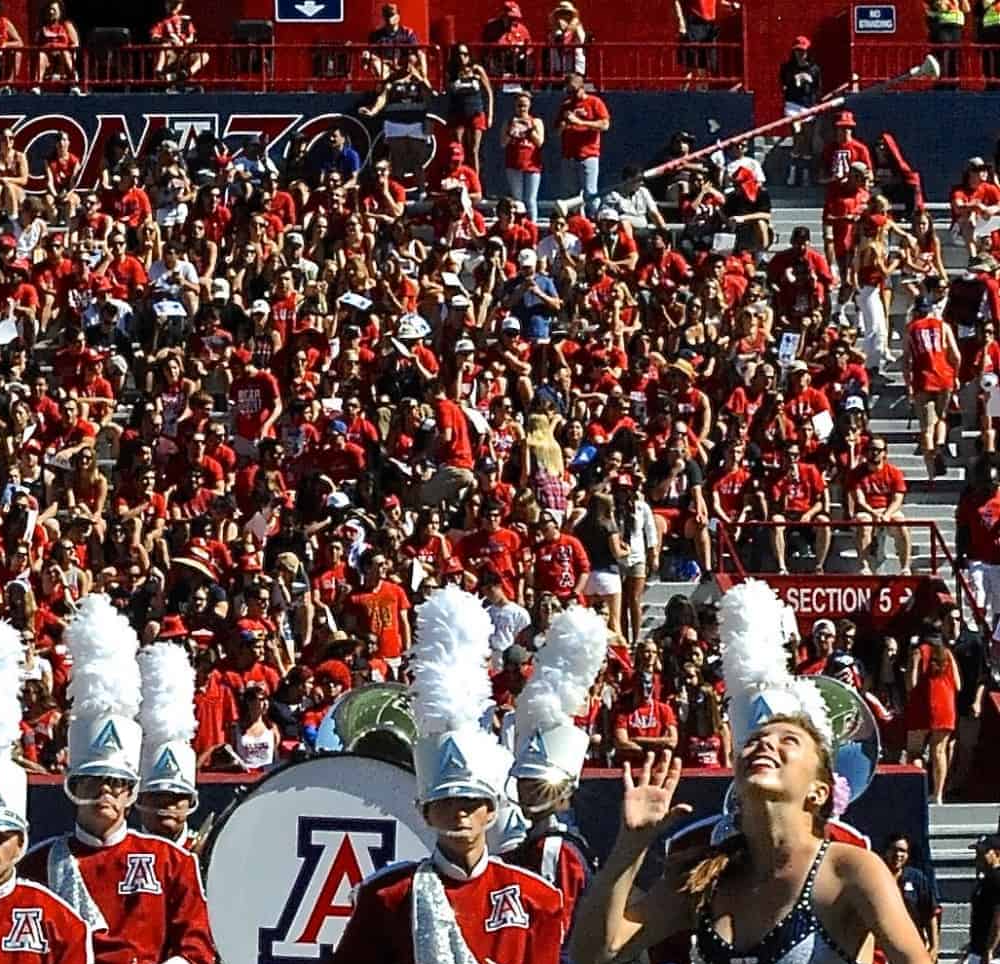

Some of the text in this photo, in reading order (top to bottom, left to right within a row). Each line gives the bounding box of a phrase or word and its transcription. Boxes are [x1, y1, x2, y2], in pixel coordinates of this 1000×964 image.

[786, 588, 892, 613] SECTION 5
[118, 854, 163, 894] A
[485, 884, 529, 932] A
[2, 908, 49, 953] A
